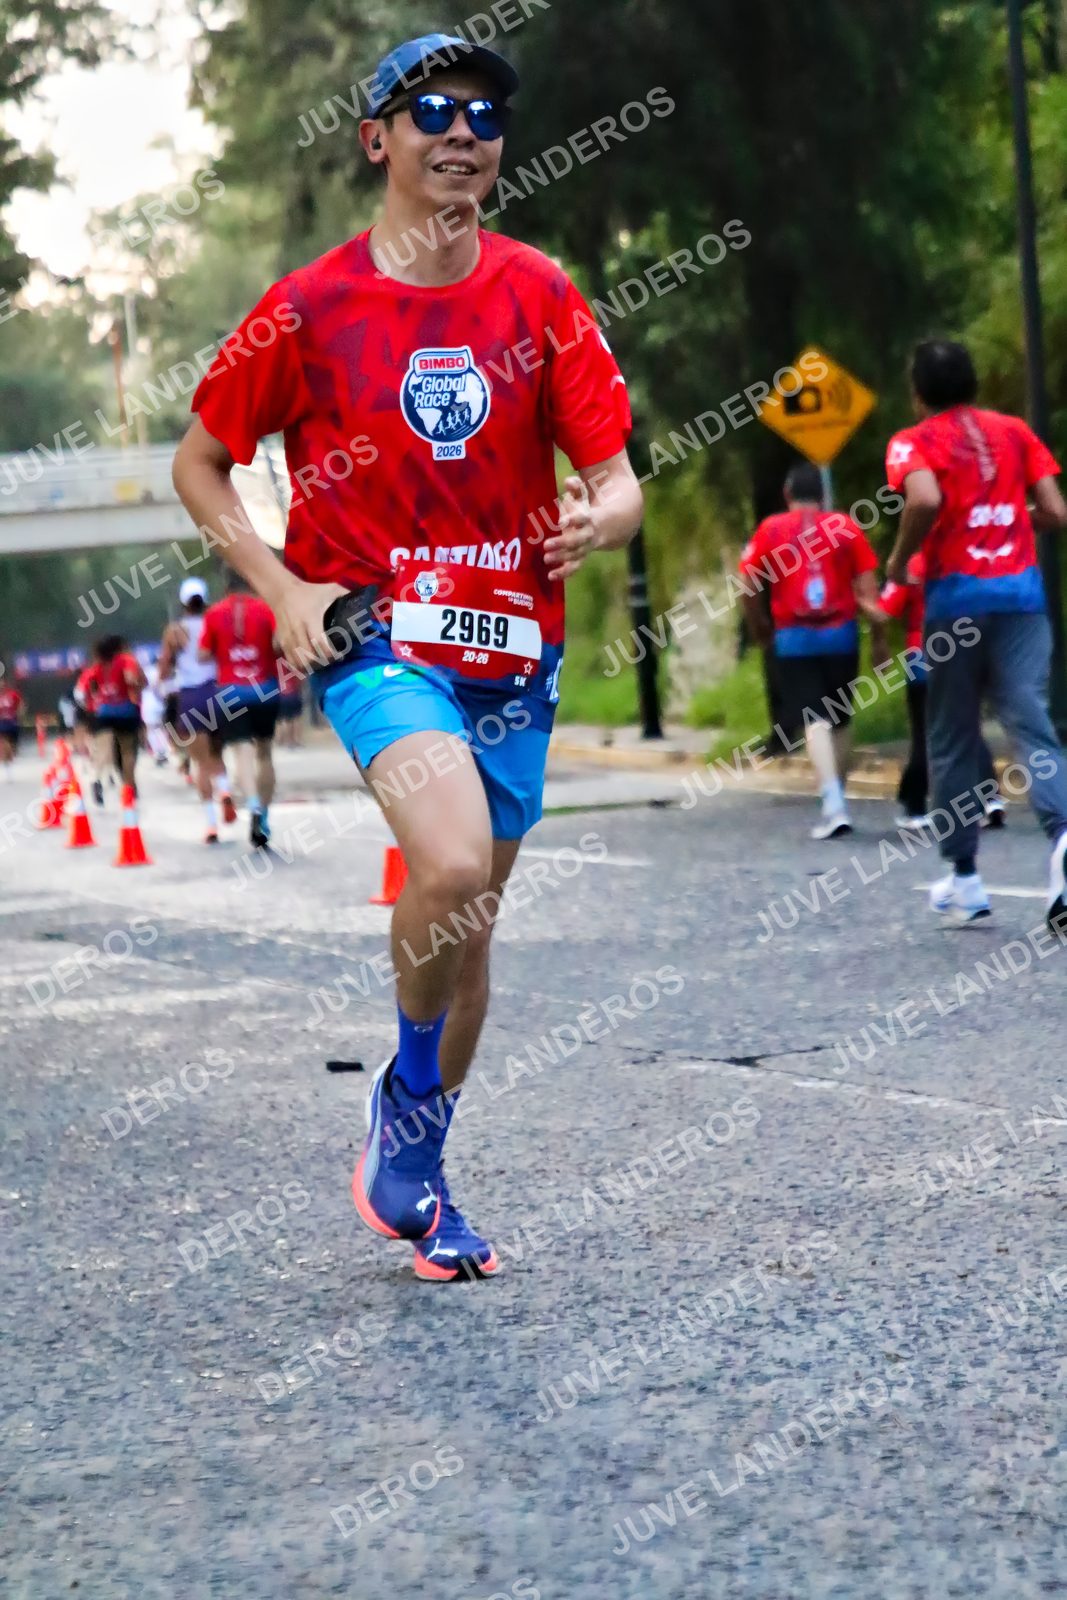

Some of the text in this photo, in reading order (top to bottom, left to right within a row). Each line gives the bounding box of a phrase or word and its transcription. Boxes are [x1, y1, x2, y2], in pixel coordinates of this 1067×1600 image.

[419, 357, 465, 370] BIMBO
[422, 374, 466, 393] Global
[414, 391, 451, 408] Race
[436, 445, 462, 457] 2026
[440, 608, 509, 650] 2969
